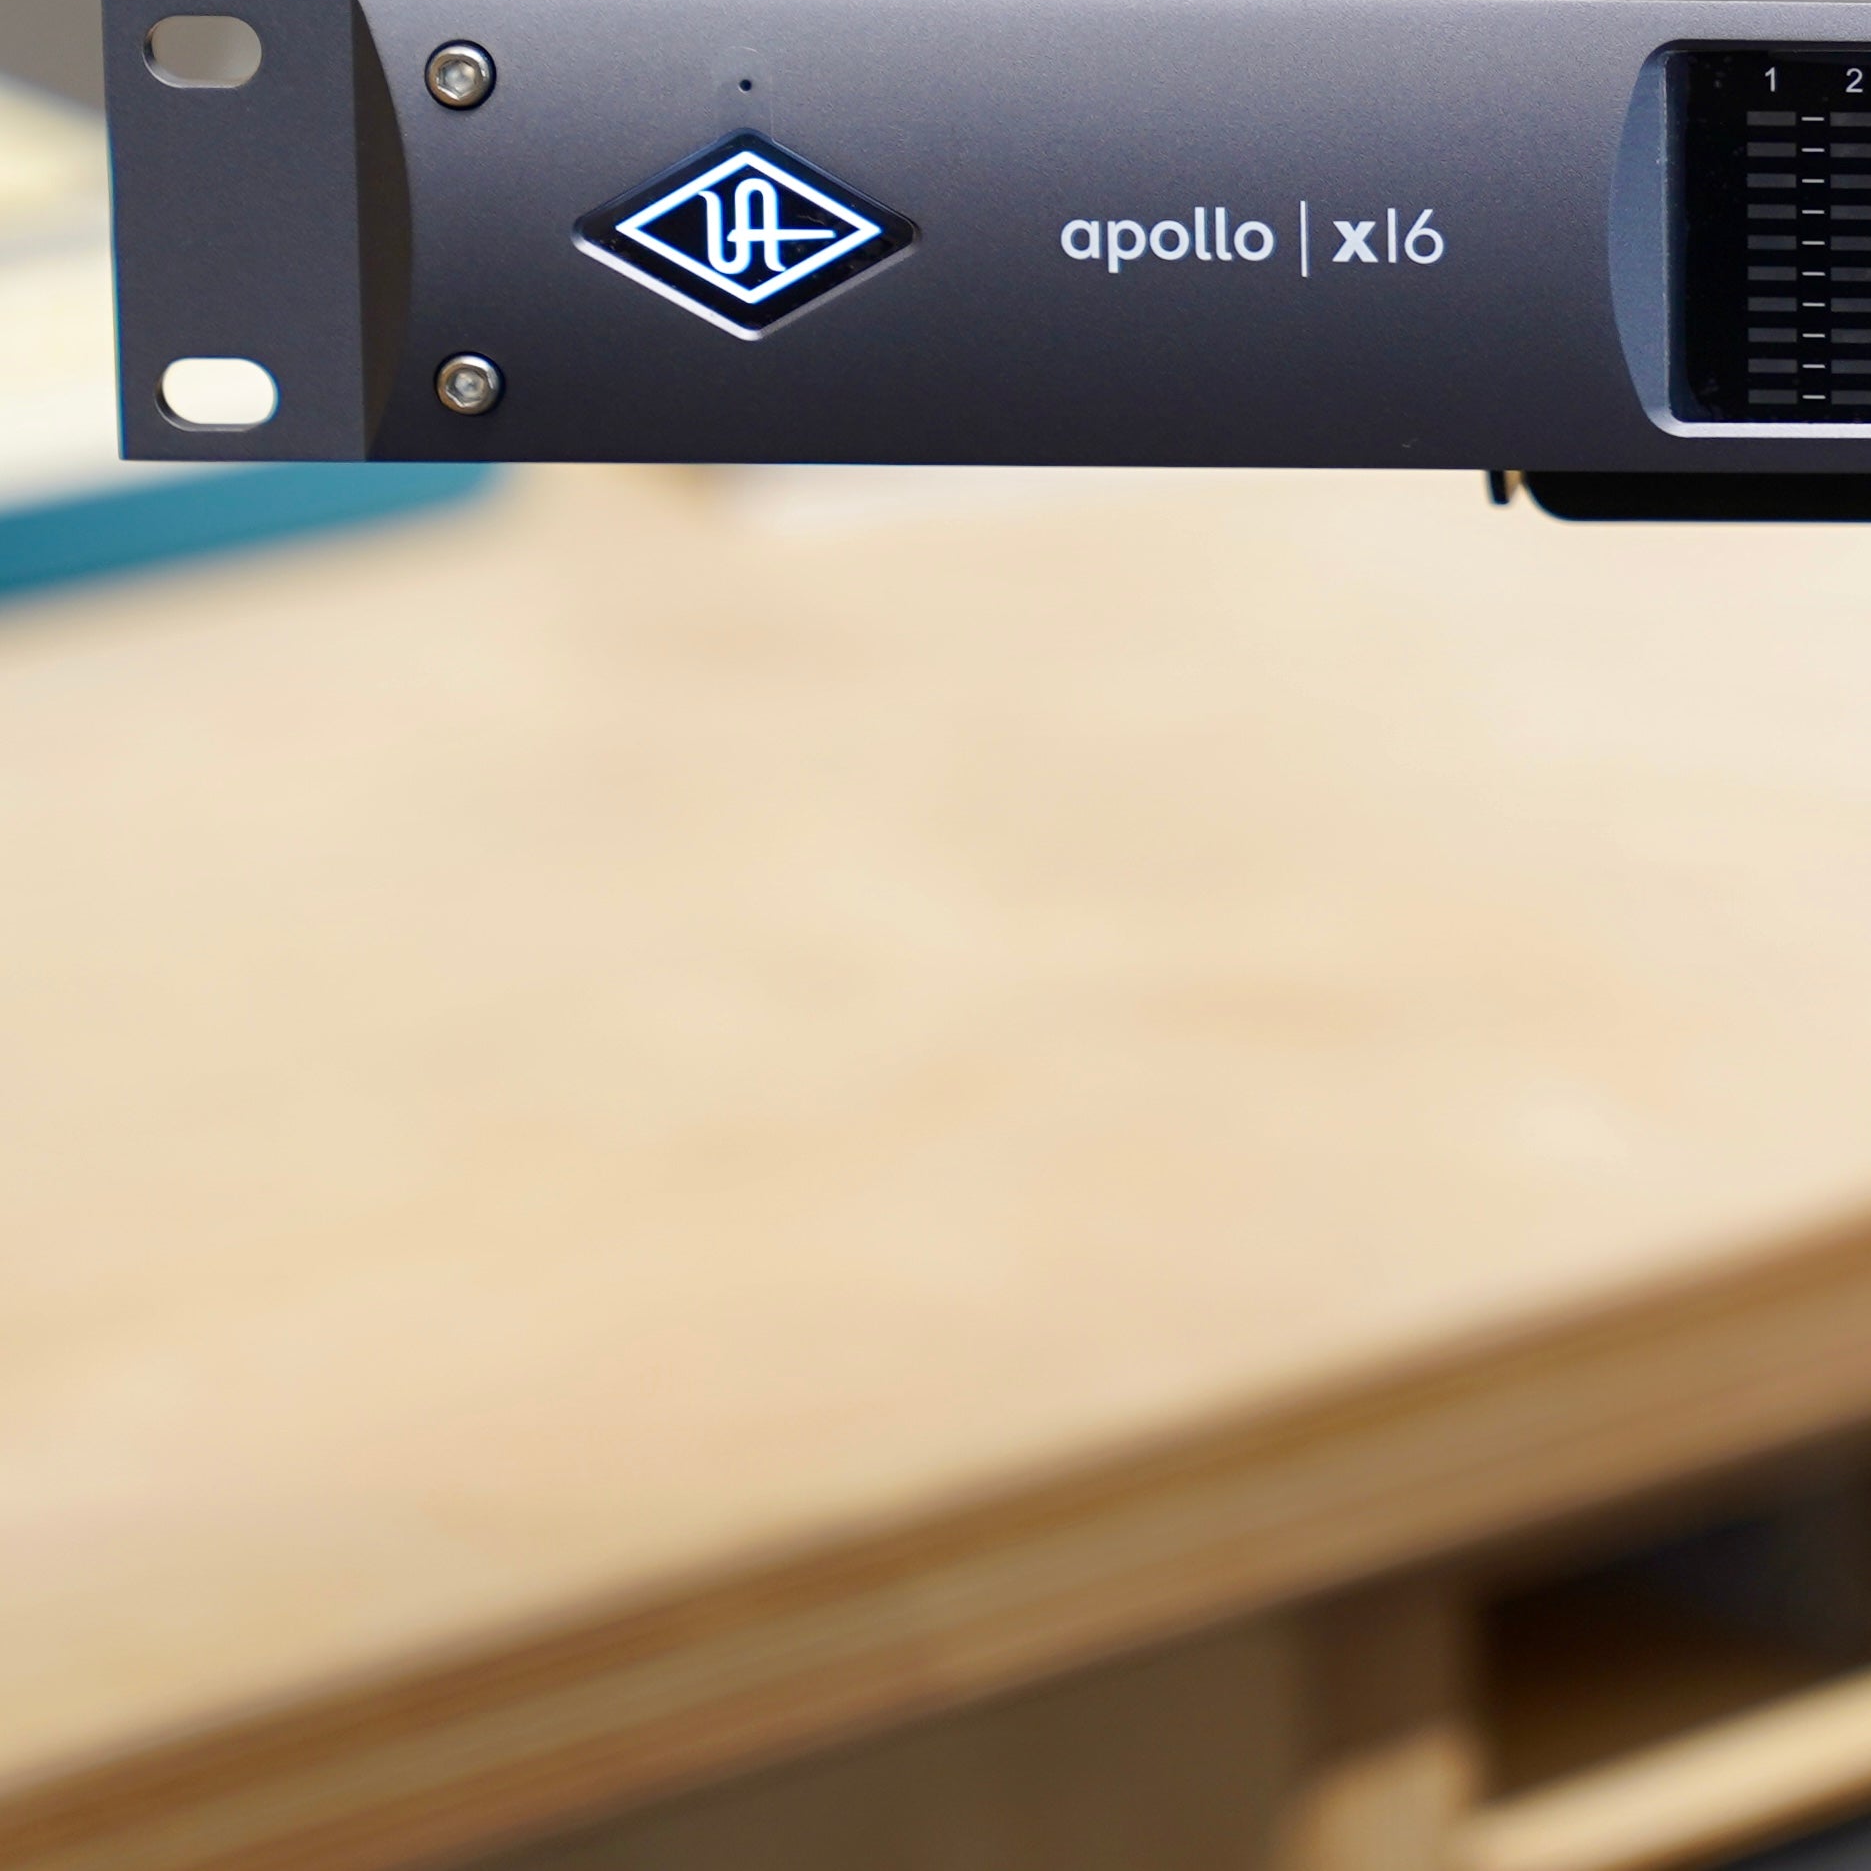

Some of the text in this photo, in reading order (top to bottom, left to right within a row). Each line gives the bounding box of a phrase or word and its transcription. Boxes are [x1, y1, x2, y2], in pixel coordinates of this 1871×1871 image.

[1764, 66, 1776, 92] 1
[1845, 67, 1864, 93] 2
[1060, 206, 1275, 274] apollo
